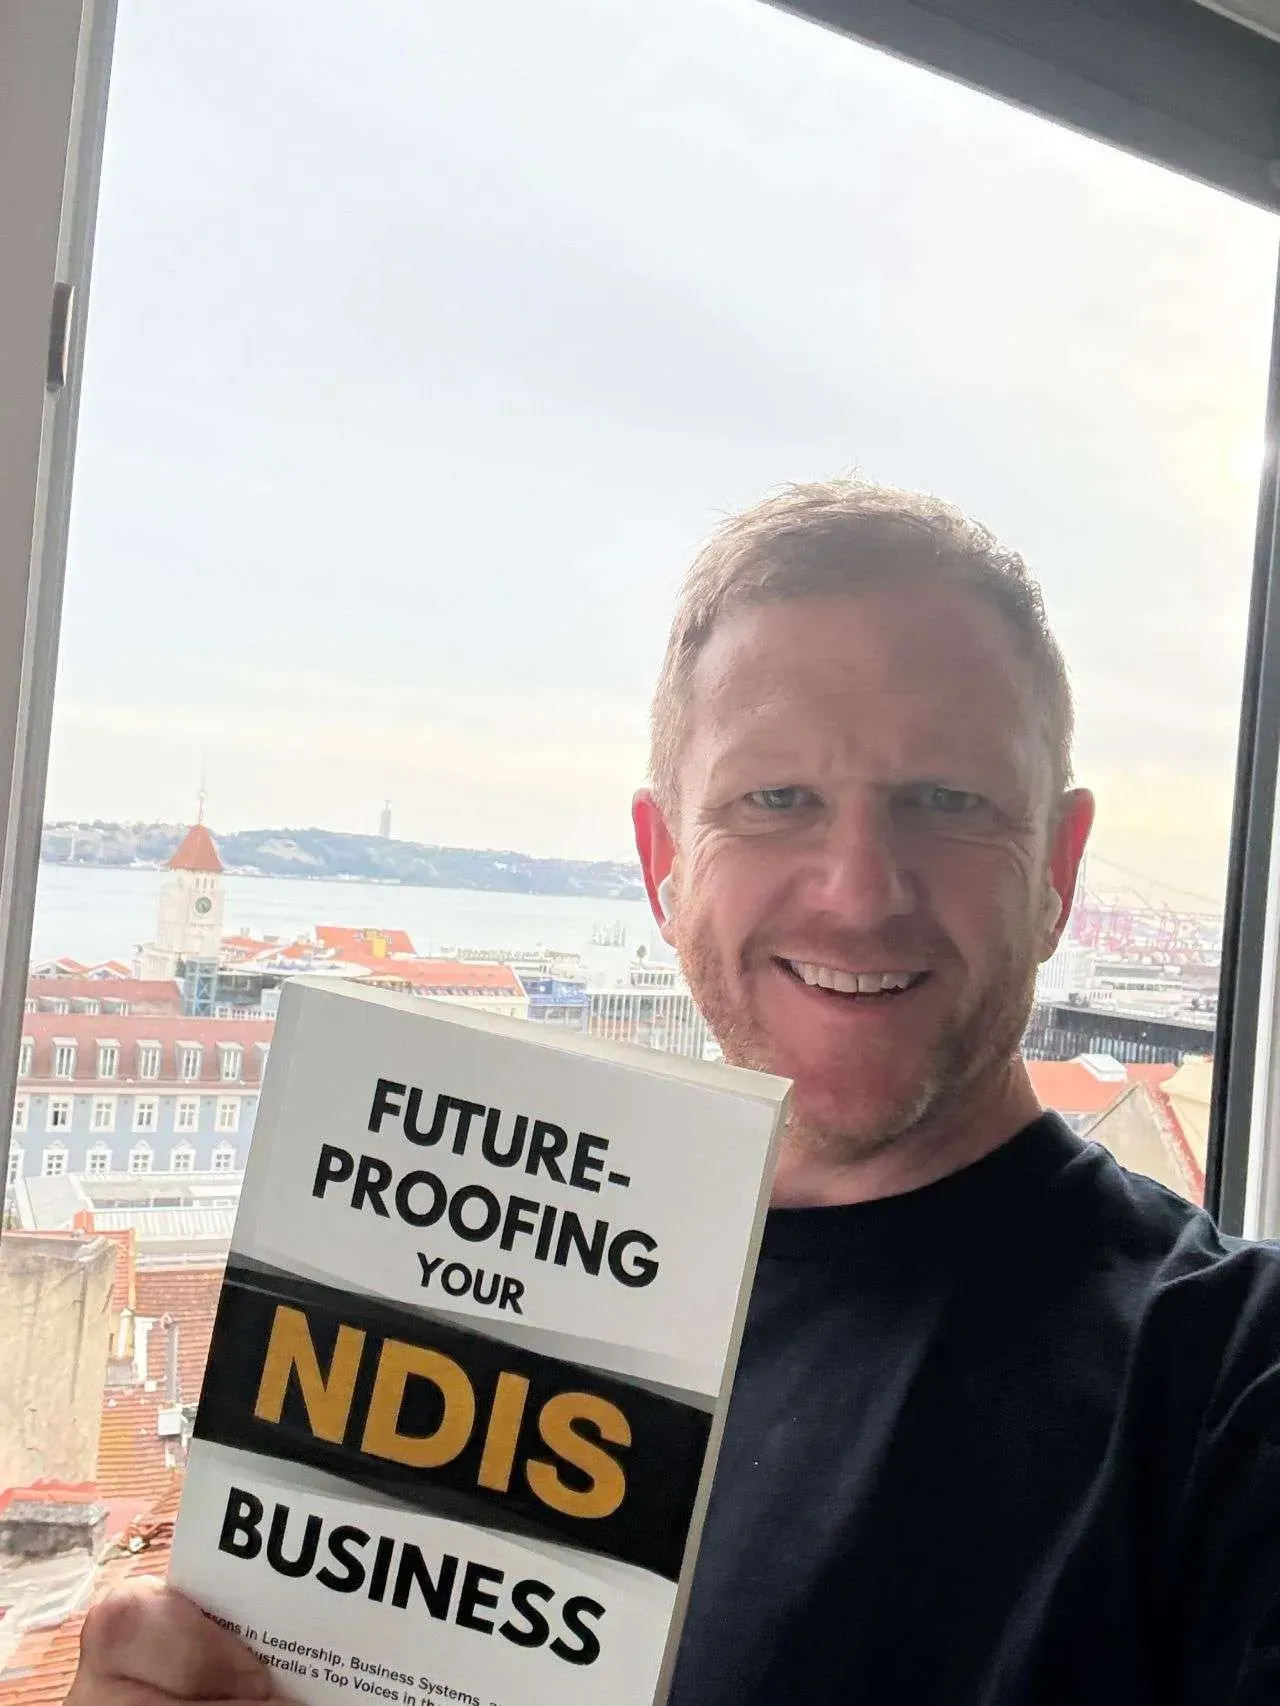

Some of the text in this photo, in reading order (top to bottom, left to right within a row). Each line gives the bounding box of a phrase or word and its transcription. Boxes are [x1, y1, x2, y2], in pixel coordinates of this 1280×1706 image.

[367, 1078, 630, 1193] FUTURE-
[312, 1143, 659, 1287] PROOFING
[416, 1252, 525, 1315] YOUR
[254, 1304, 632, 1519] NDIS
[218, 1486, 606, 1666] BUSINESS
[246, 1625, 258, 1640] in
[262, 1630, 345, 1666] Leadership,
[350, 1656, 414, 1686] Business
[323, 1668, 349, 1687] Top
[353, 1677, 399, 1701] Voices
[403, 1691, 416, 1706] in
